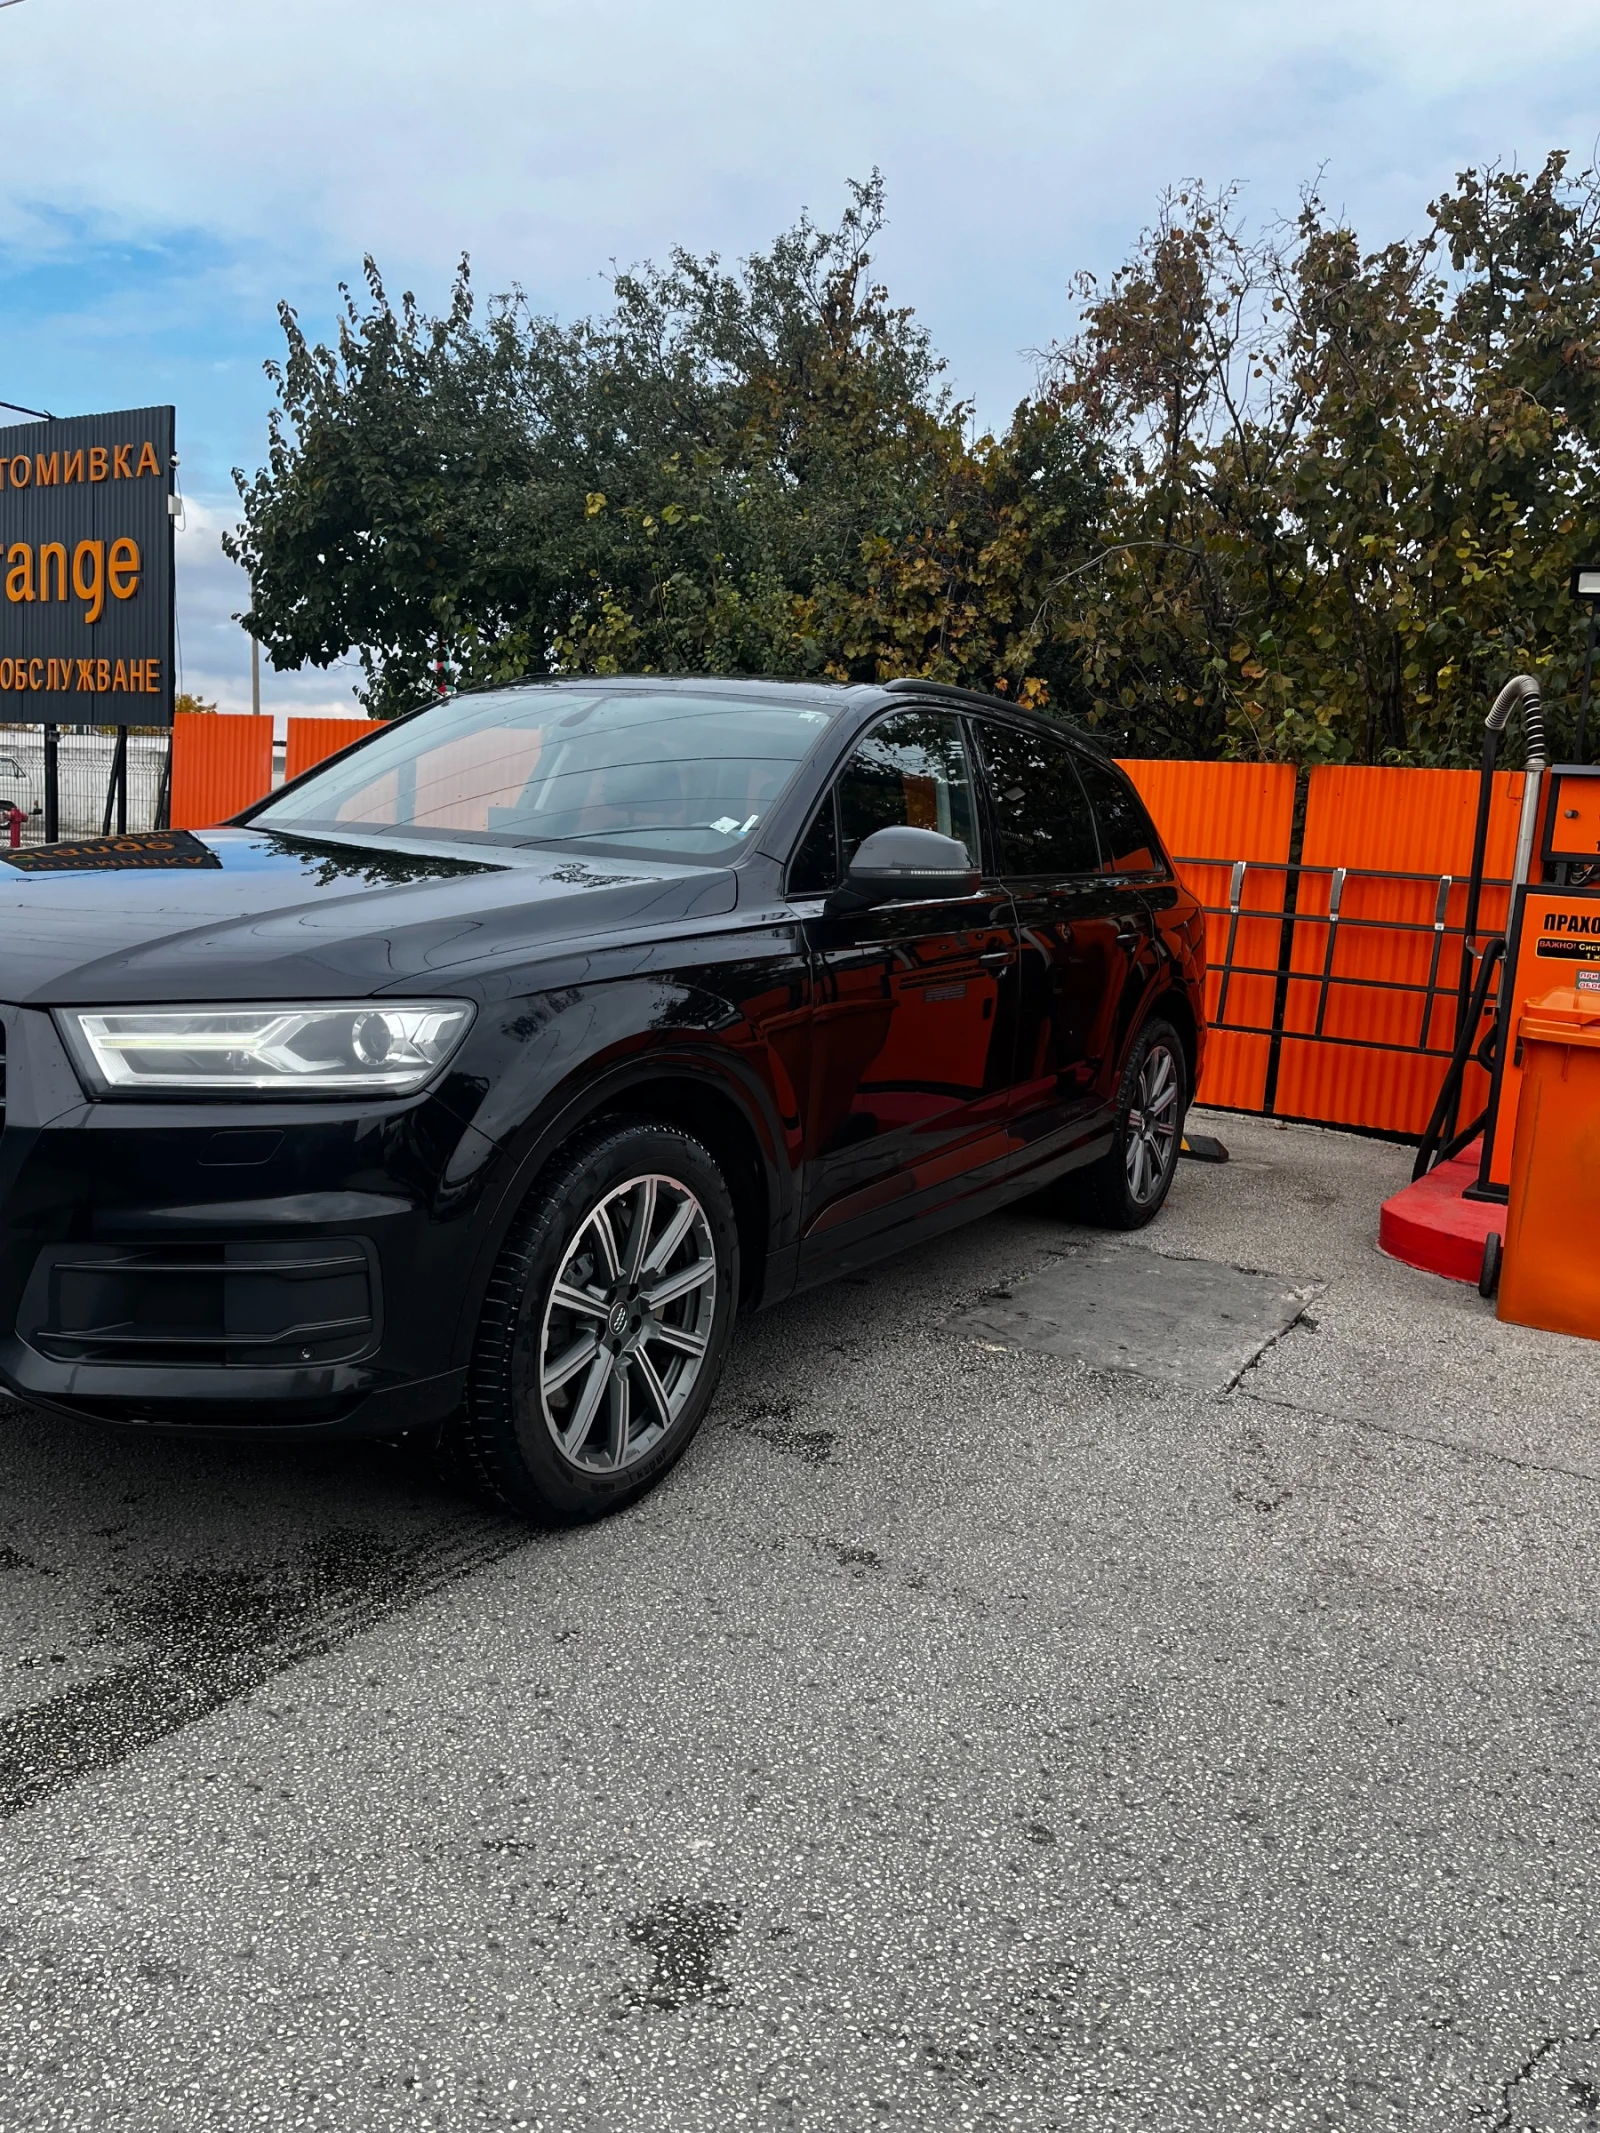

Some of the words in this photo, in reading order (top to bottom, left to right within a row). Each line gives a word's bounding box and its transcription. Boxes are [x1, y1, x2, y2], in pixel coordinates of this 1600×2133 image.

[0, 537, 141, 624] ange
[1, 657, 161, 693] ОБСЛУЖВАНЕ
[1543, 913, 1600, 935] ПРАХО
[1539, 940, 1577, 950] ВАЖНО!
